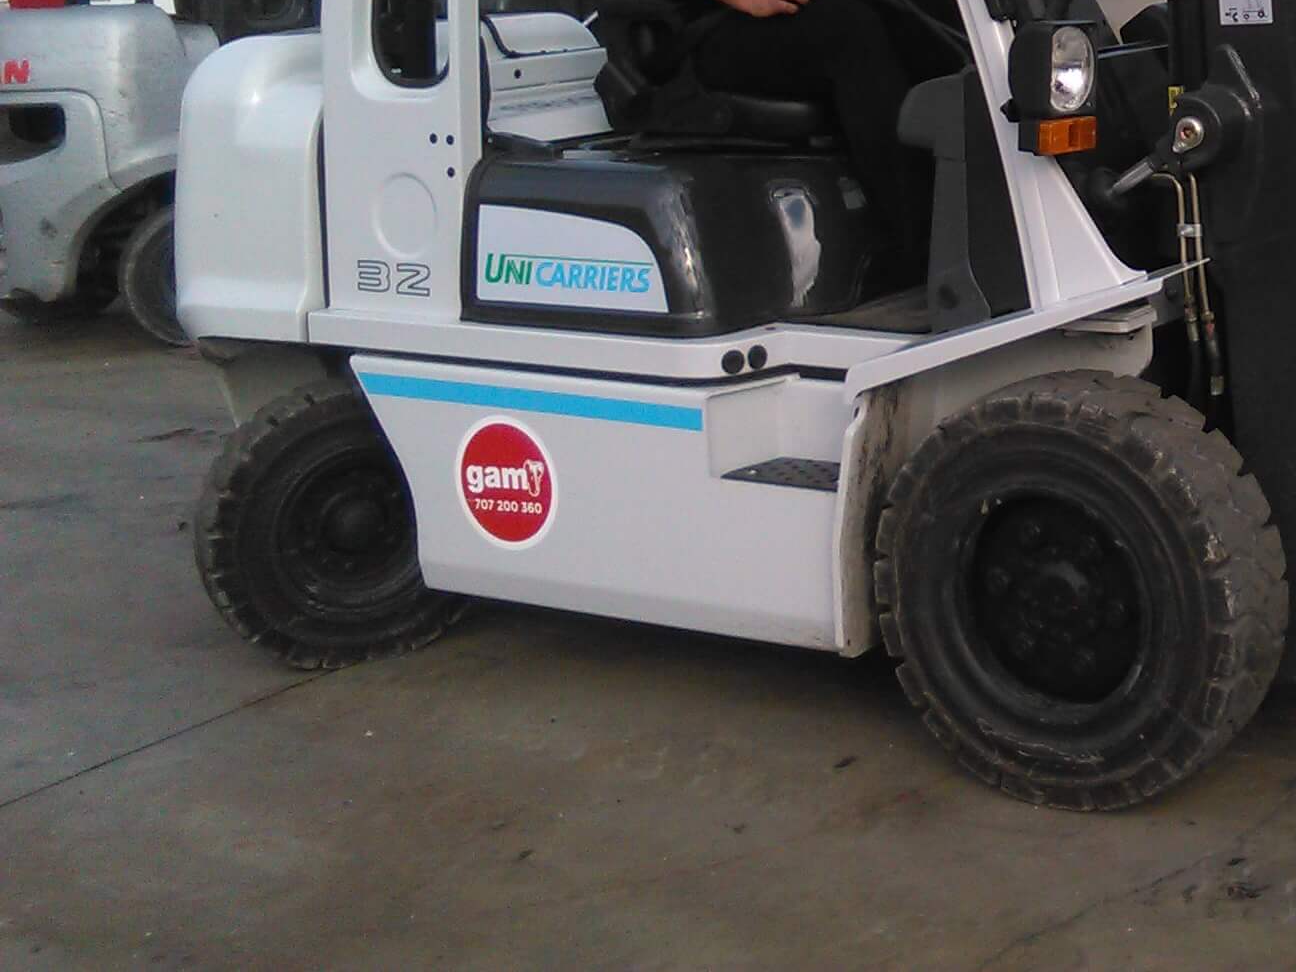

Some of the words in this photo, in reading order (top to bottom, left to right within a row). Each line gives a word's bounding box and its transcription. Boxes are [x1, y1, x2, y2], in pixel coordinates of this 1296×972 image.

[356, 259, 431, 297] 32
[466, 464, 529, 494] gam
[474, 498, 495, 512] 707
[496, 499, 519, 513] 200
[521, 500, 543, 515] 360
